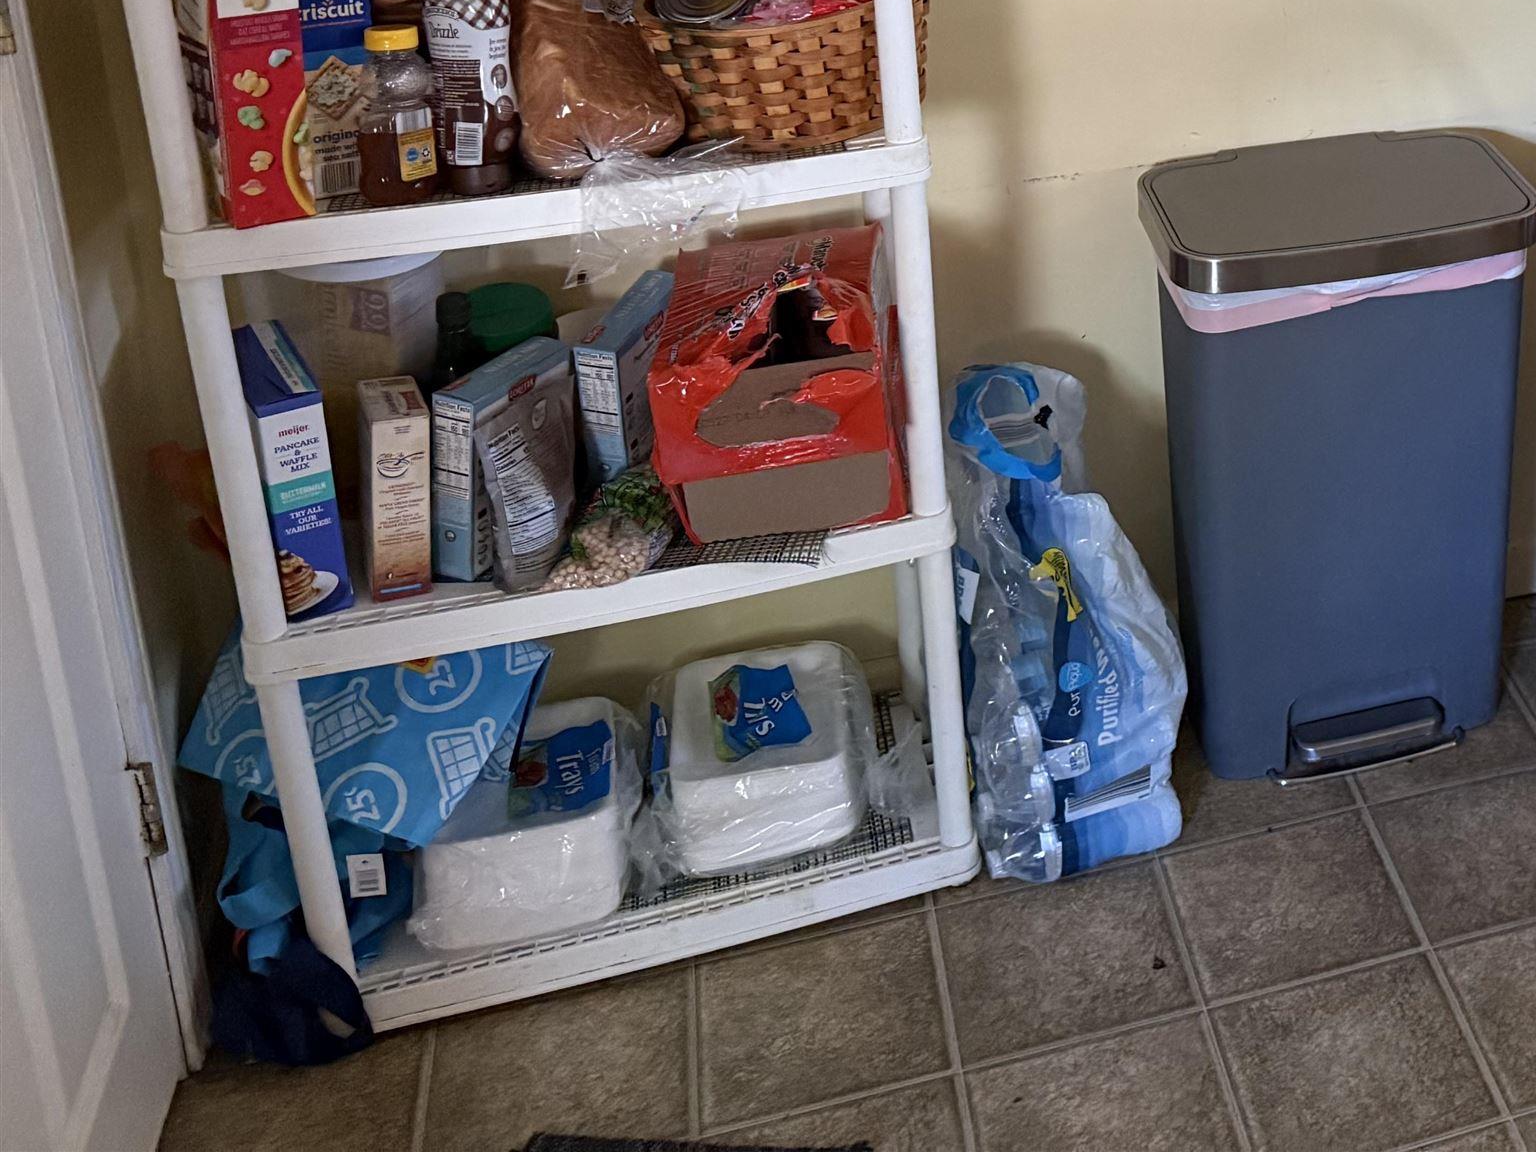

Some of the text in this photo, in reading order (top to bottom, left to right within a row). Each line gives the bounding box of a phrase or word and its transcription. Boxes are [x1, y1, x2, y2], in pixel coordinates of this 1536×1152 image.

[313, 129, 360, 144] origina
[278, 424, 309, 438] meijer
[274, 436, 320, 454] PANCAKE
[280, 452, 318, 468] WAFFLE
[290, 462, 310, 473] MIX
[289, 505, 324, 520] TRY ALL
[297, 514, 317, 525] OUR
[1097, 670, 1123, 746] Purified
[555, 749, 584, 795] Trays
